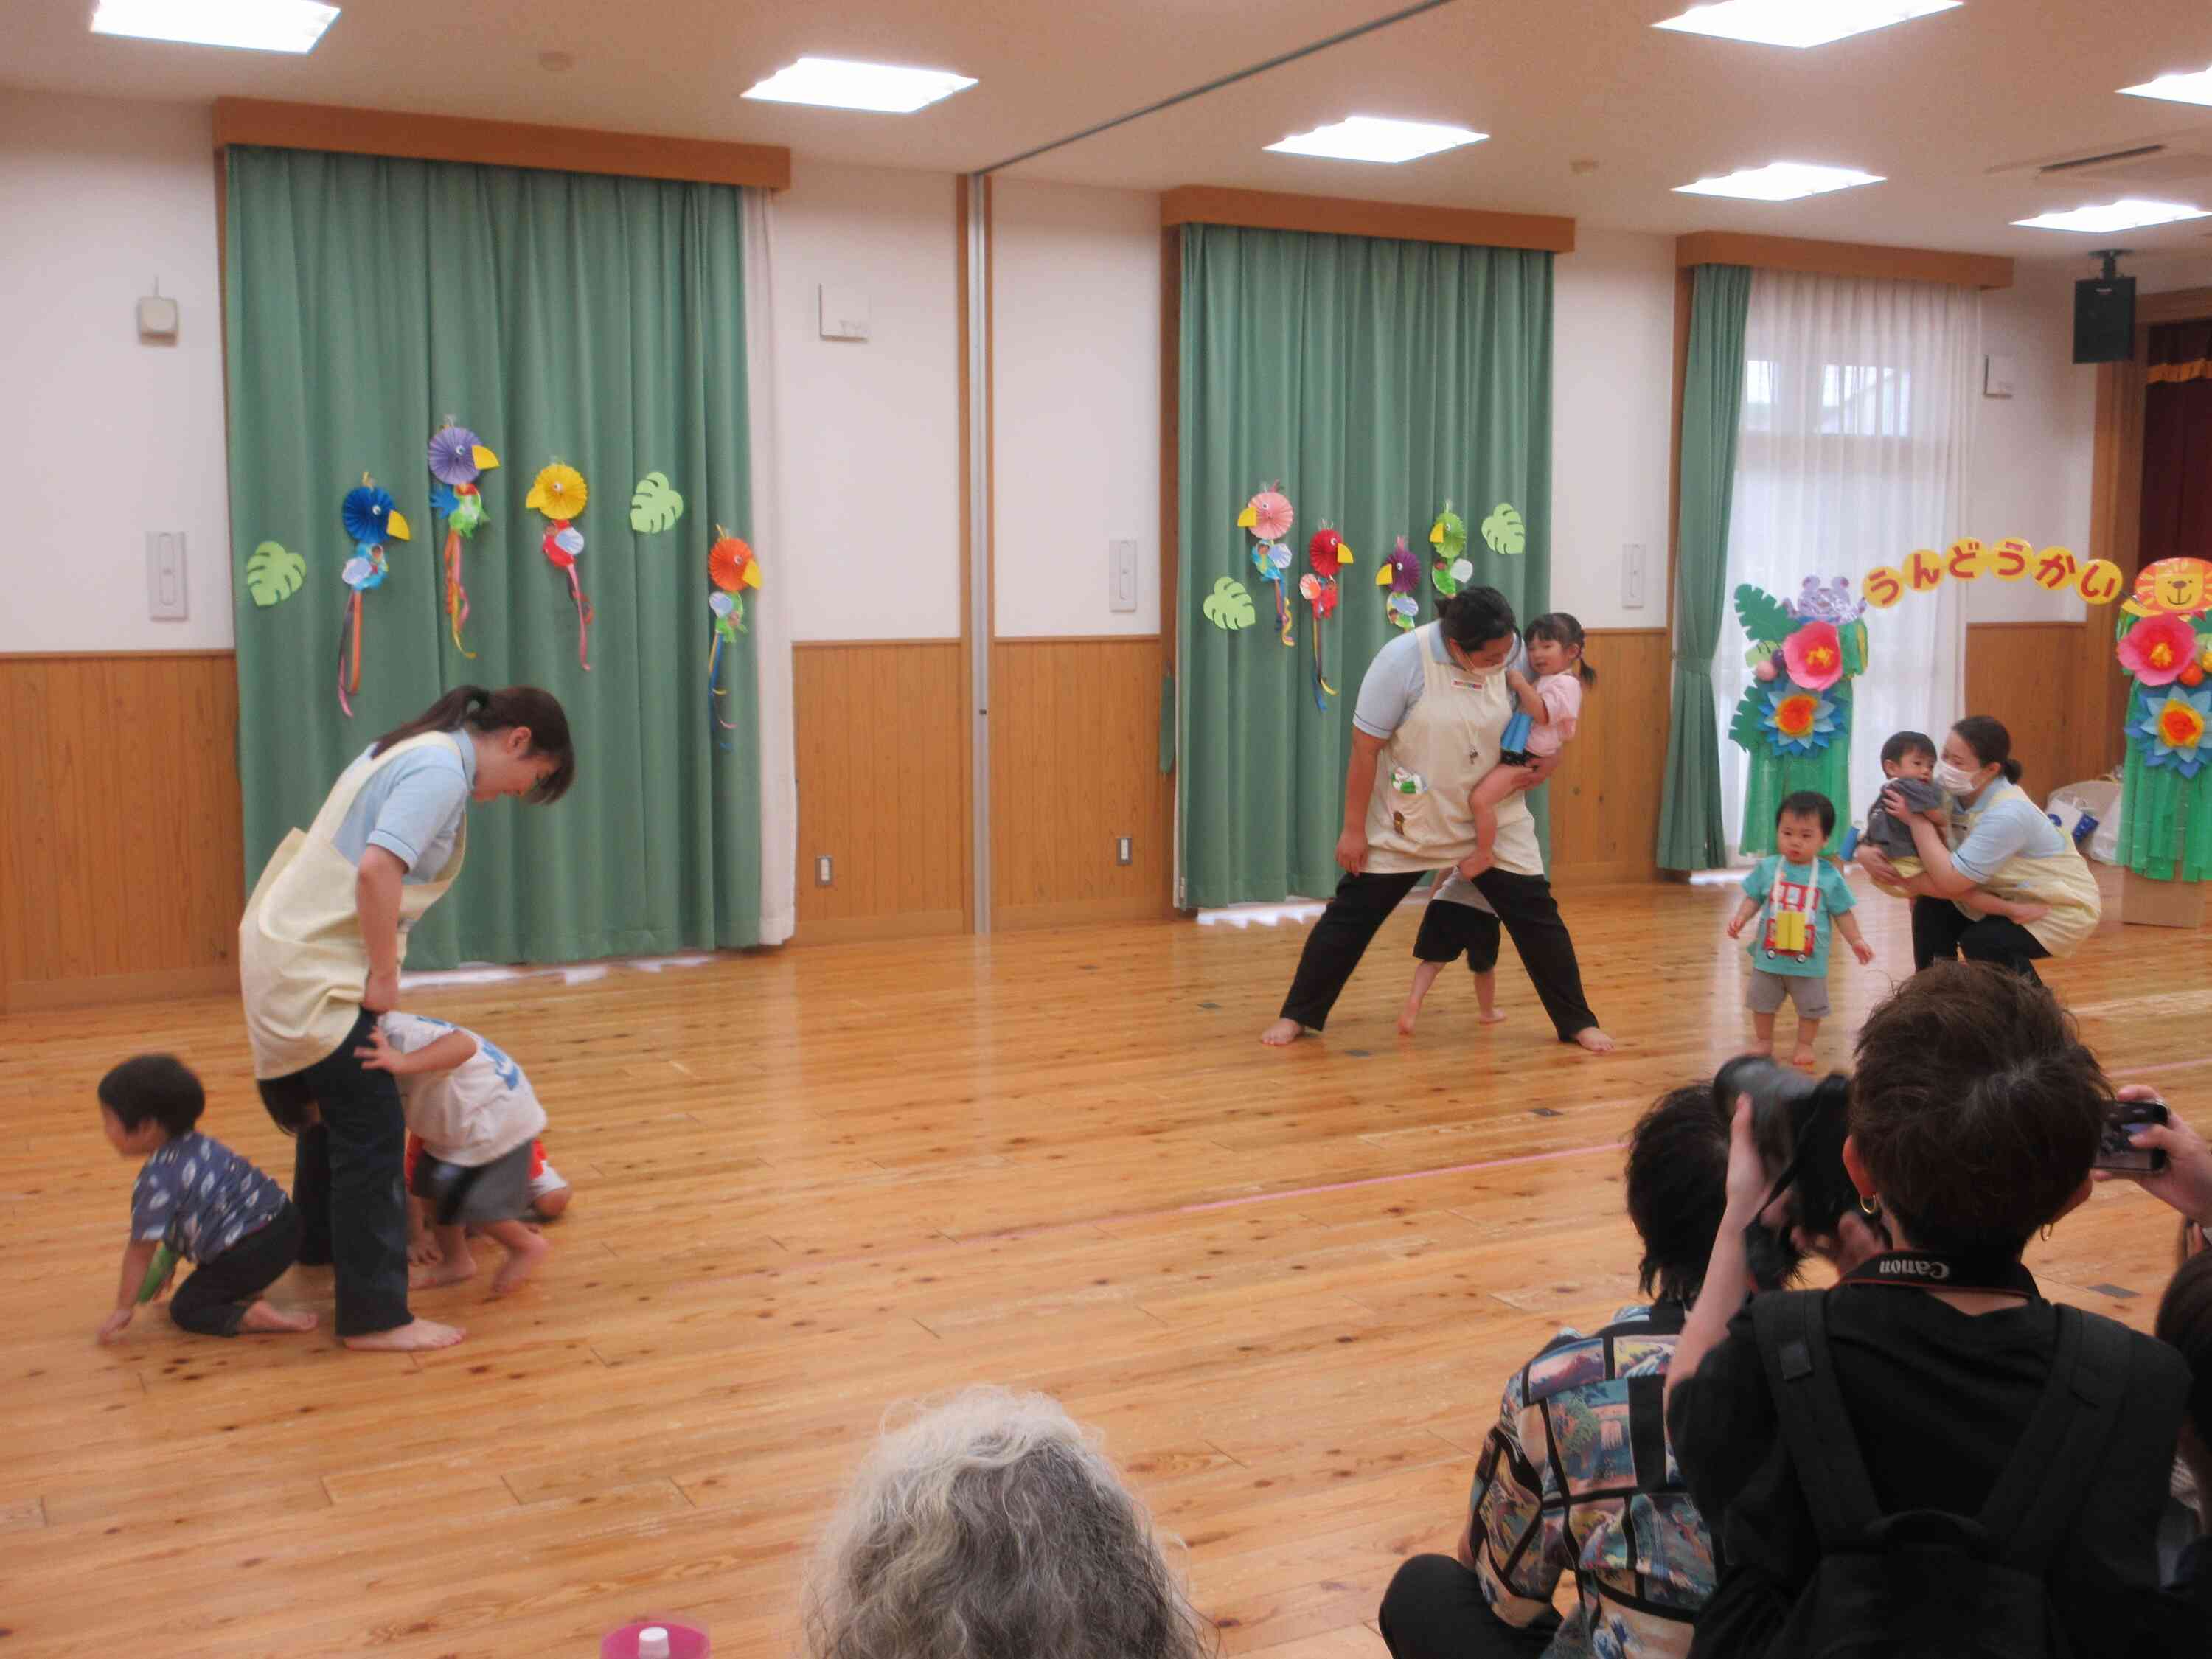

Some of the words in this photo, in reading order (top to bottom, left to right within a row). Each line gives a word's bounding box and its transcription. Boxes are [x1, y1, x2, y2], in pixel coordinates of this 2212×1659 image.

[1869, 541, 2116, 605] うんどうかい
[1879, 1259, 1950, 1280] Canon
